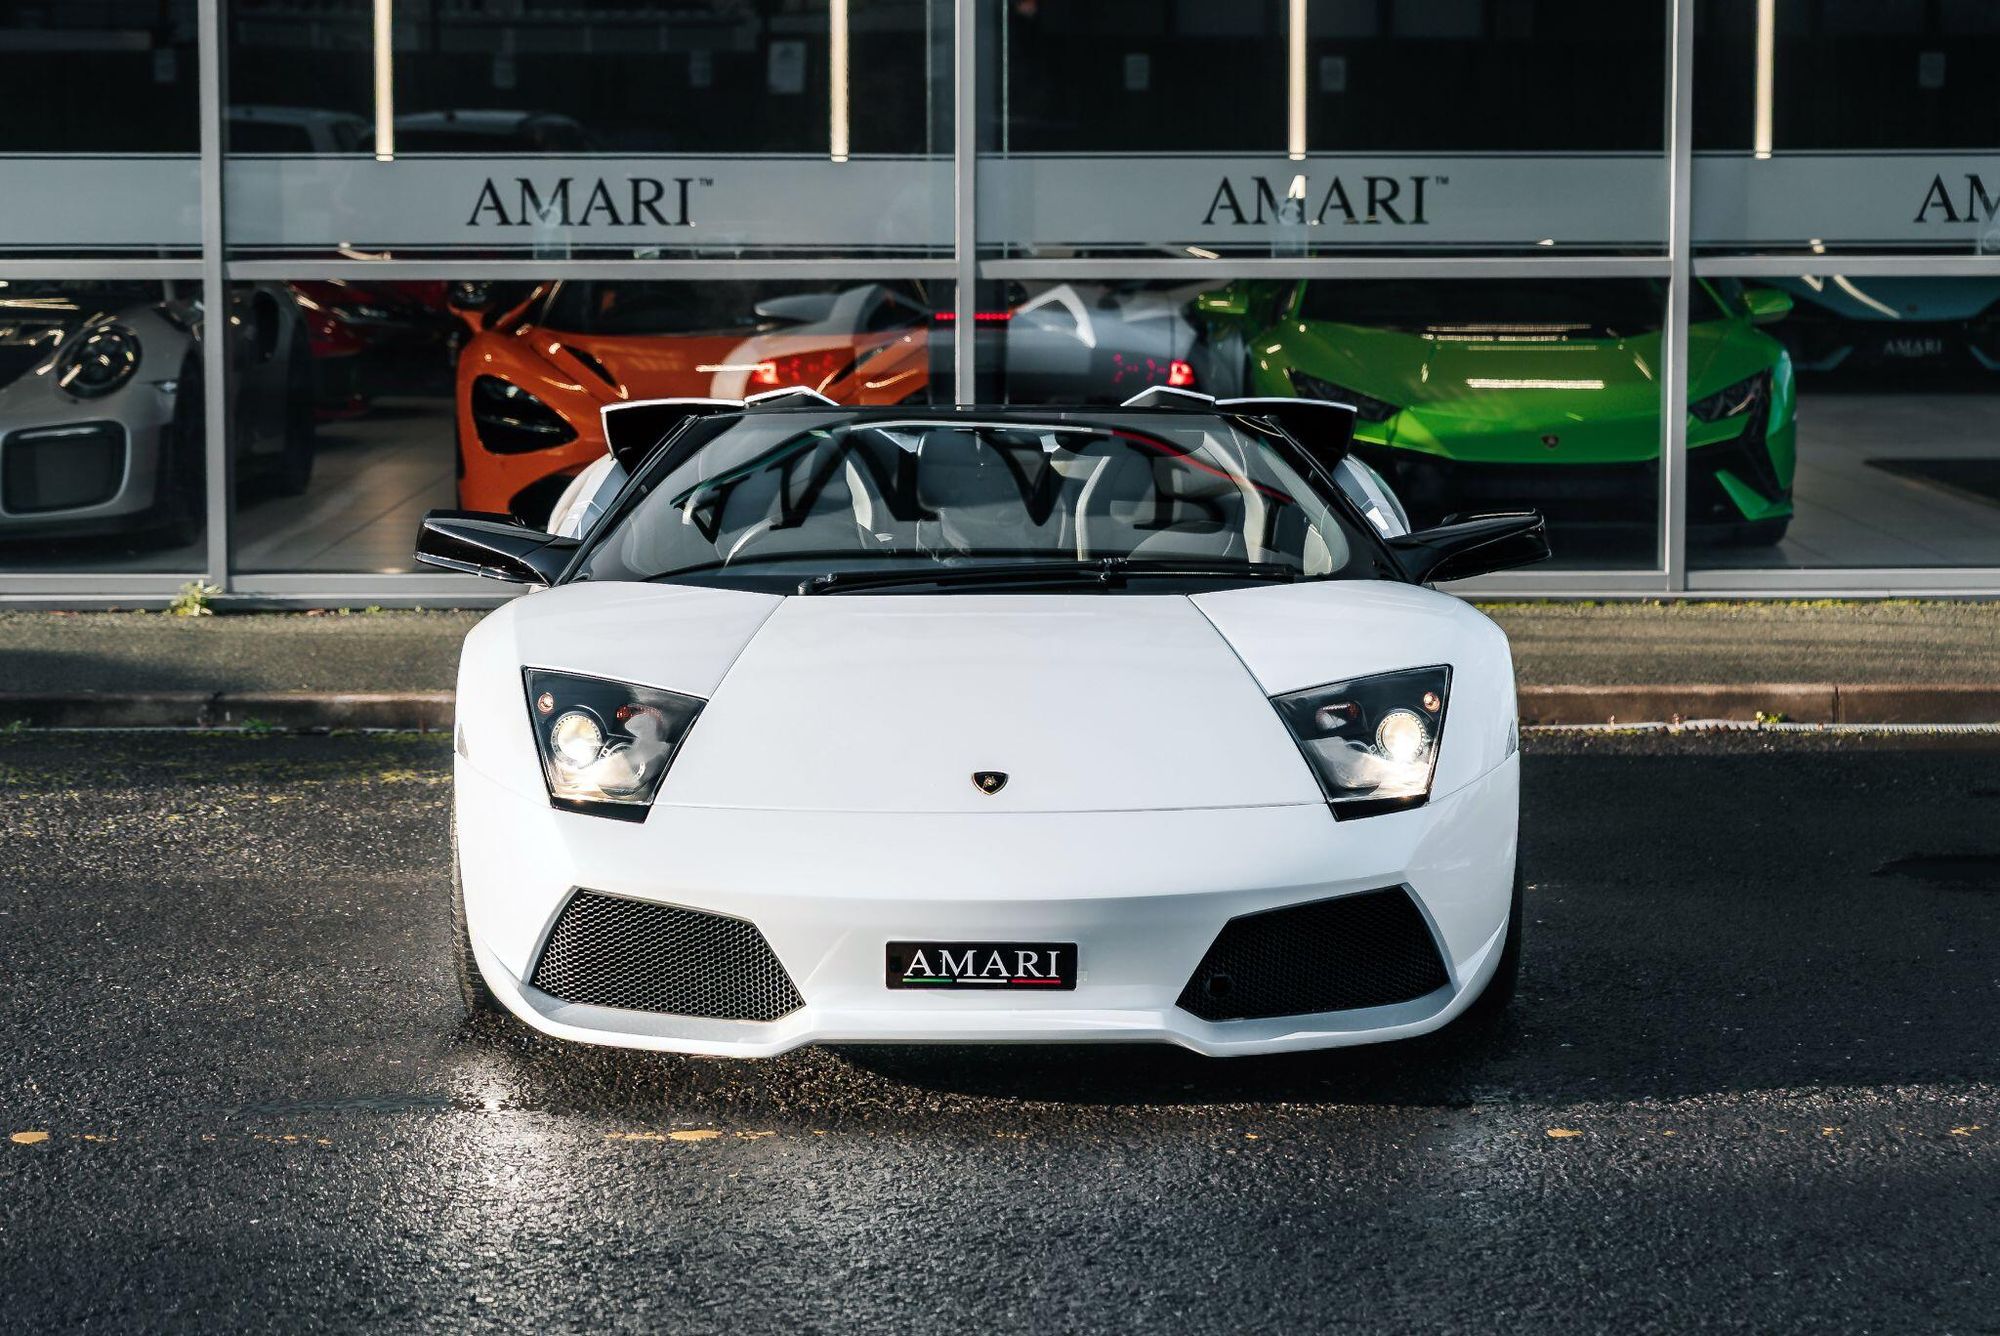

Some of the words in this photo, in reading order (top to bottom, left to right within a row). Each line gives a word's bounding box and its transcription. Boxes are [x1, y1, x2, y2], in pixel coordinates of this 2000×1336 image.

[466, 177, 694, 226] AMARI
[1202, 175, 1429, 226] AMARI
[904, 949, 1061, 977] AMARI
